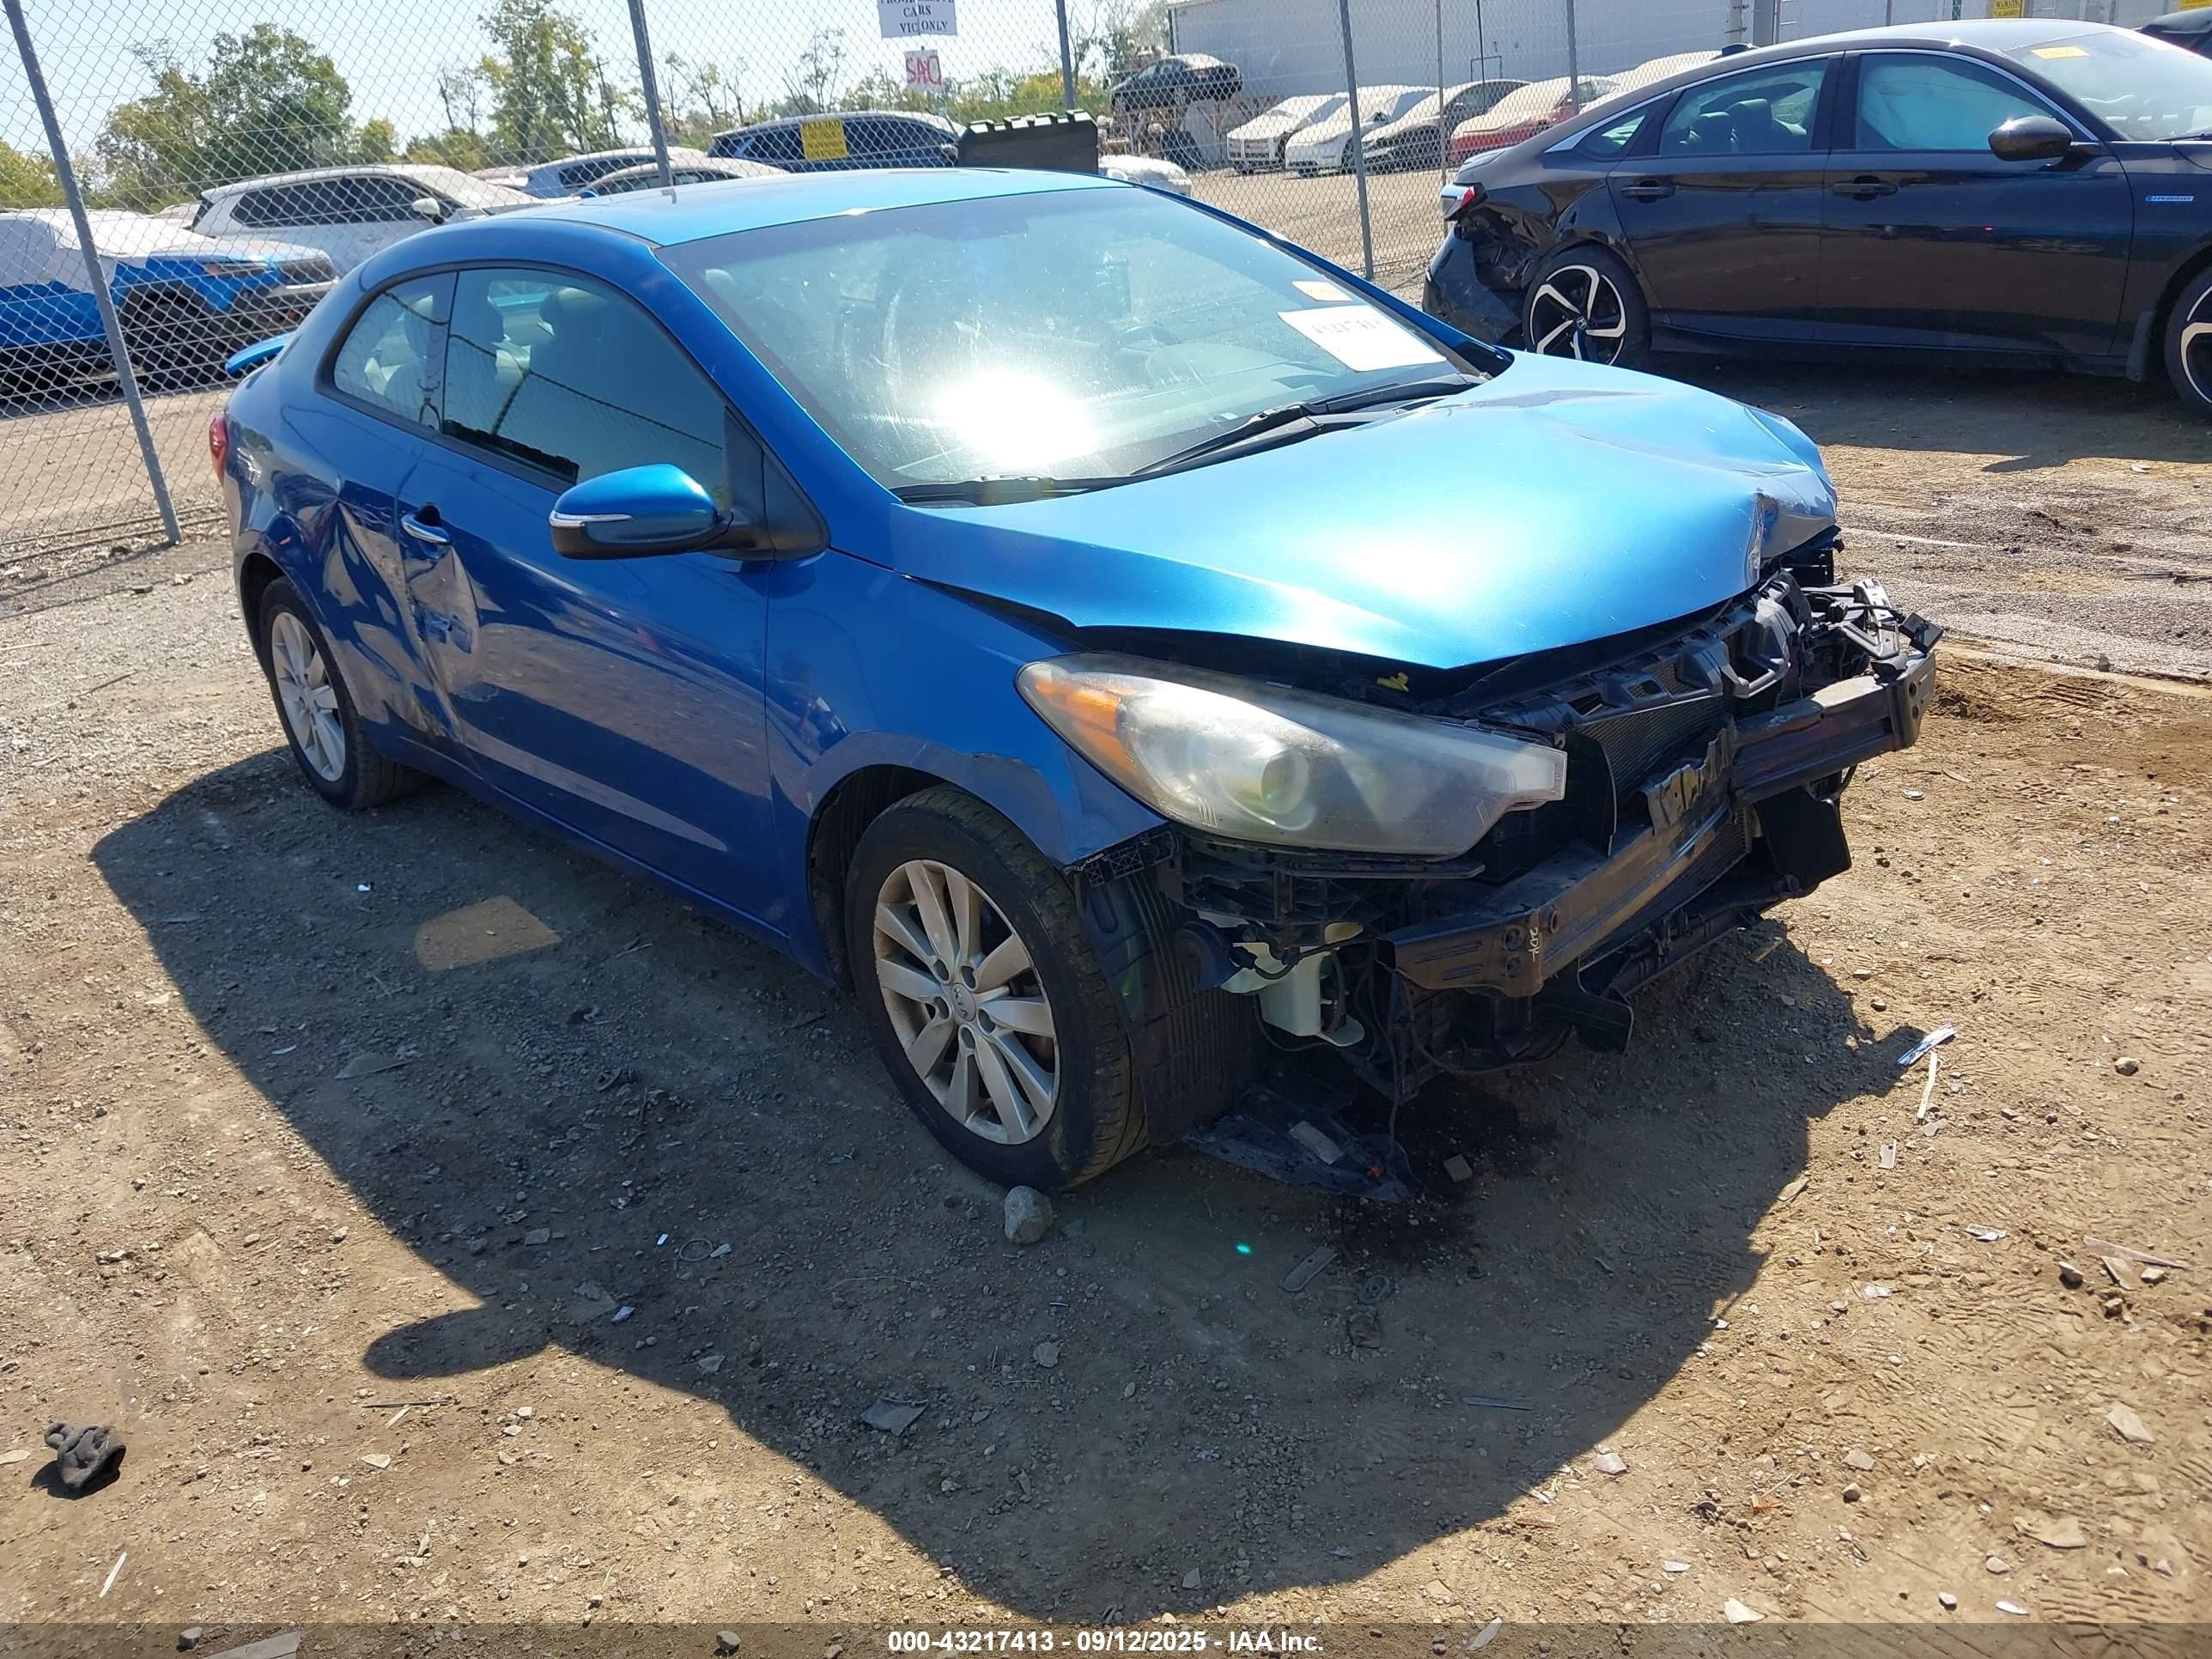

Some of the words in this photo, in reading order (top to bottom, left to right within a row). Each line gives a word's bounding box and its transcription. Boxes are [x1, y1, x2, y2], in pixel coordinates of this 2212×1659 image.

[903, 5, 932, 18] CARS
[900, 22, 918, 33] VIC
[921, 20, 948, 32] ONLY
